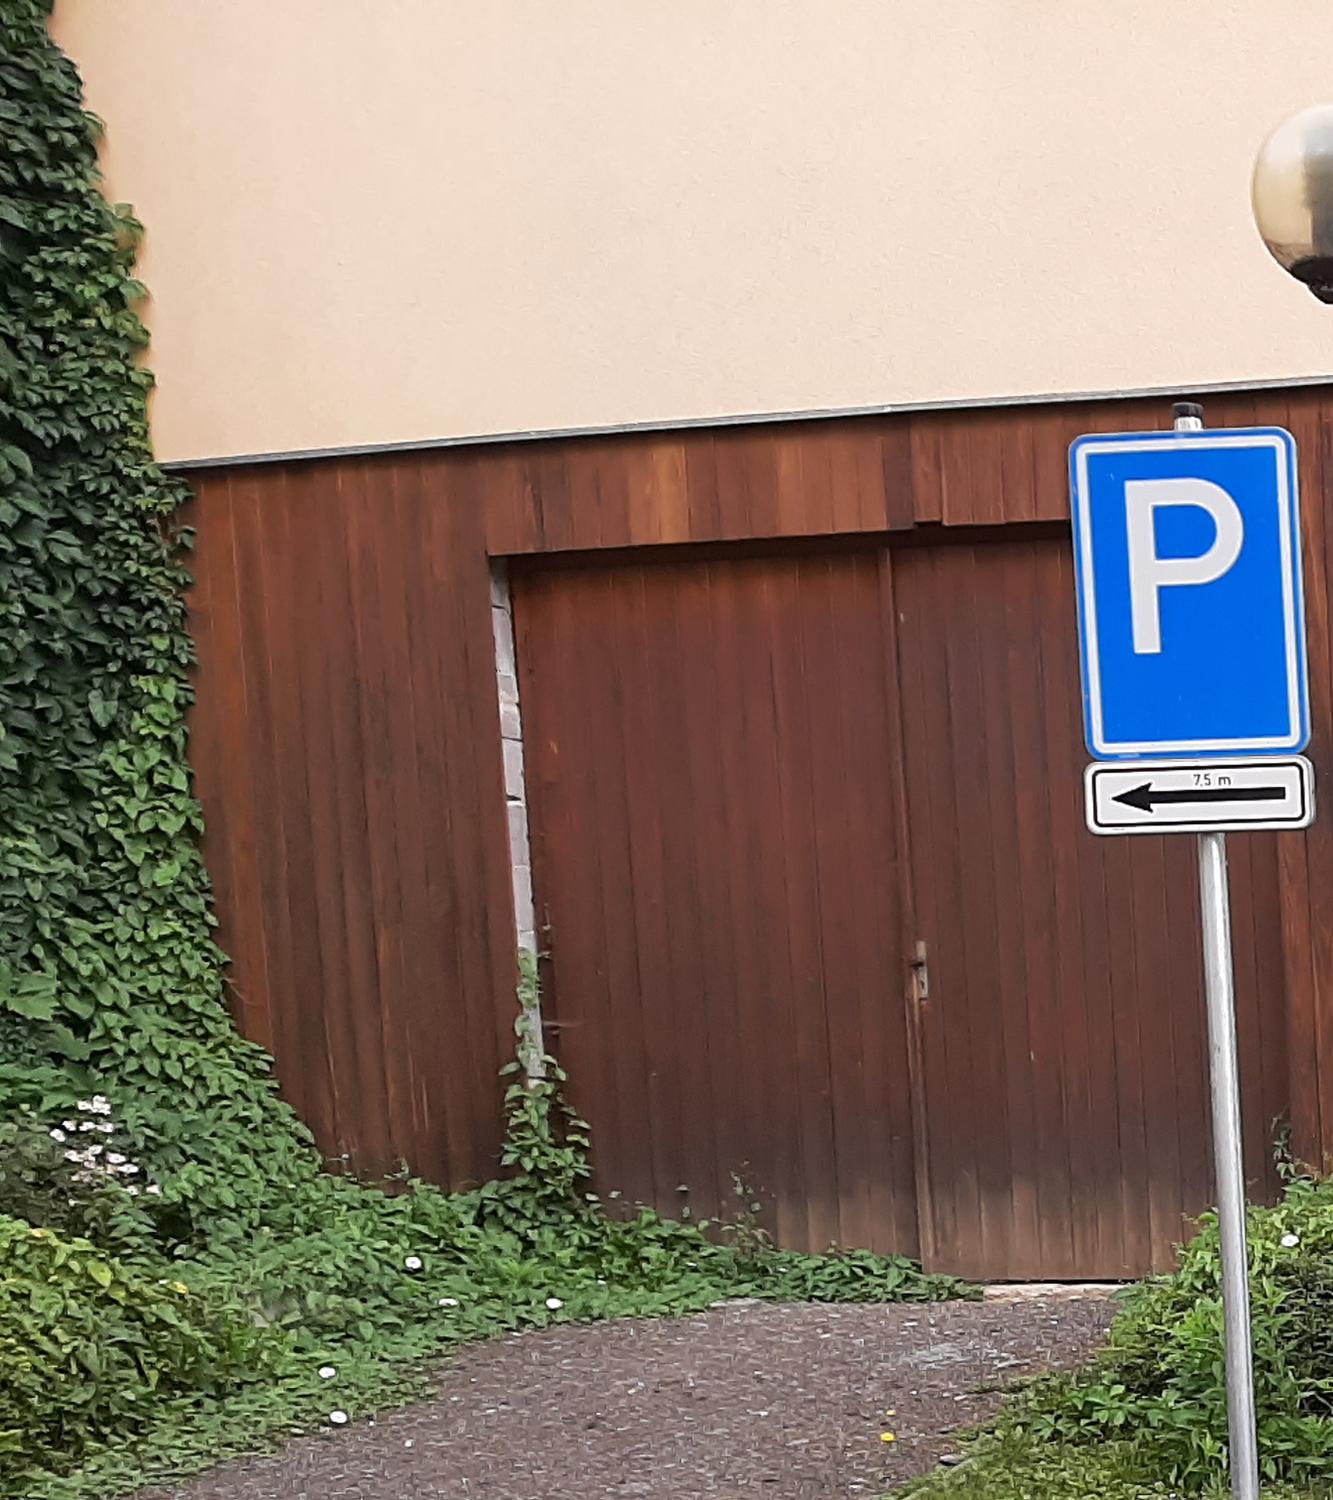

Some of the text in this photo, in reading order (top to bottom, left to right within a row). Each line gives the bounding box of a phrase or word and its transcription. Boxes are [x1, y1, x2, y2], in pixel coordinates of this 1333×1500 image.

[1124, 477, 1244, 654] P
[1193, 772, 1232, 787] 7,5 m
